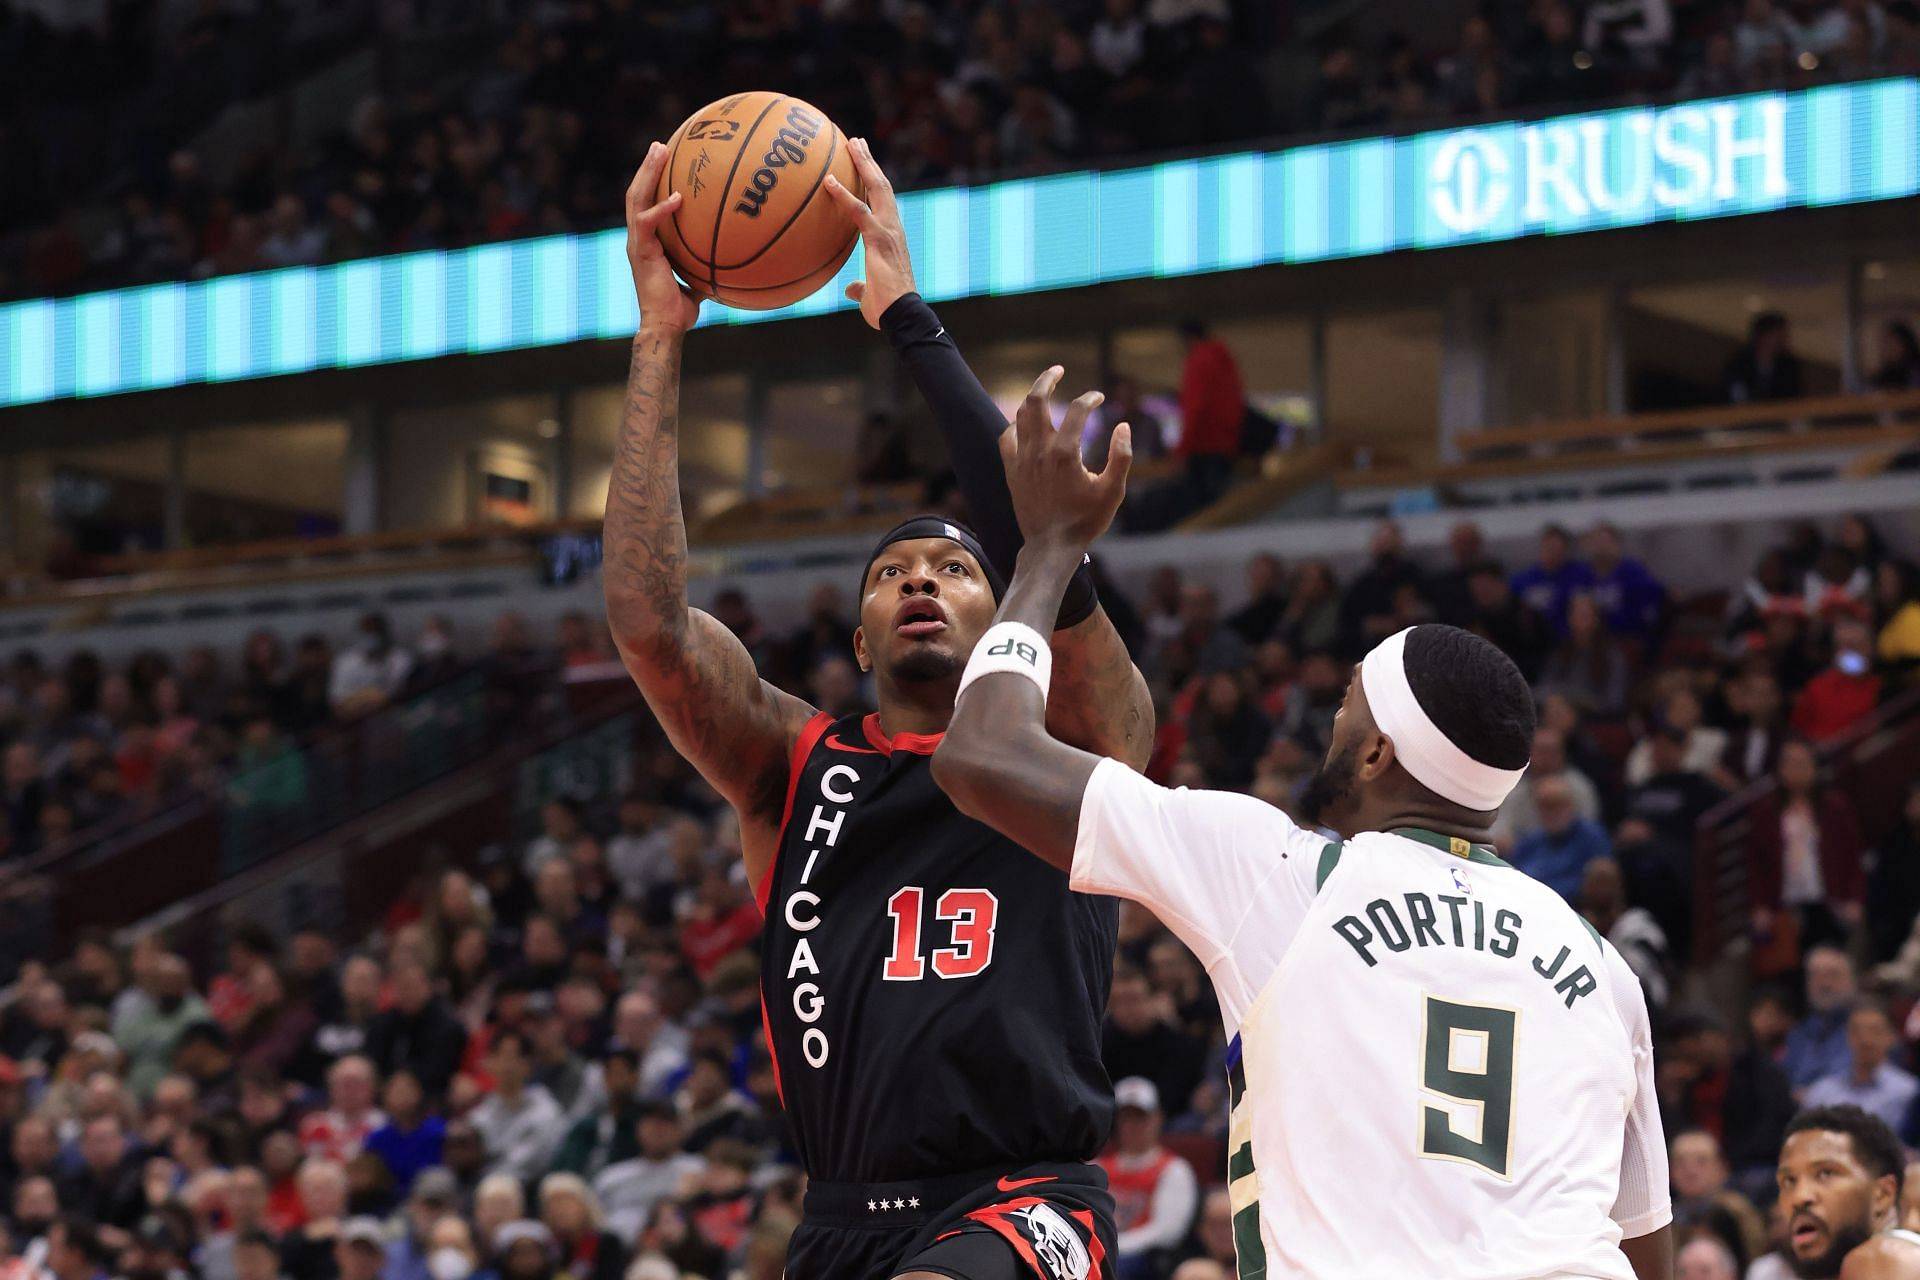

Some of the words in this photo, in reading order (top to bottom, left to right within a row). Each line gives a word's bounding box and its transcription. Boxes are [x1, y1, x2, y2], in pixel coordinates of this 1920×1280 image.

[733, 105, 823, 219] Wilson
[1519, 96, 1786, 222] RUSH
[987, 638, 1038, 667] BP
[784, 764, 861, 1069] CHICAGO
[882, 886, 999, 982] 13
[1331, 892, 1523, 968] PORTIS
[1531, 945, 1598, 1010] JR
[1417, 991, 1523, 1183] 9
